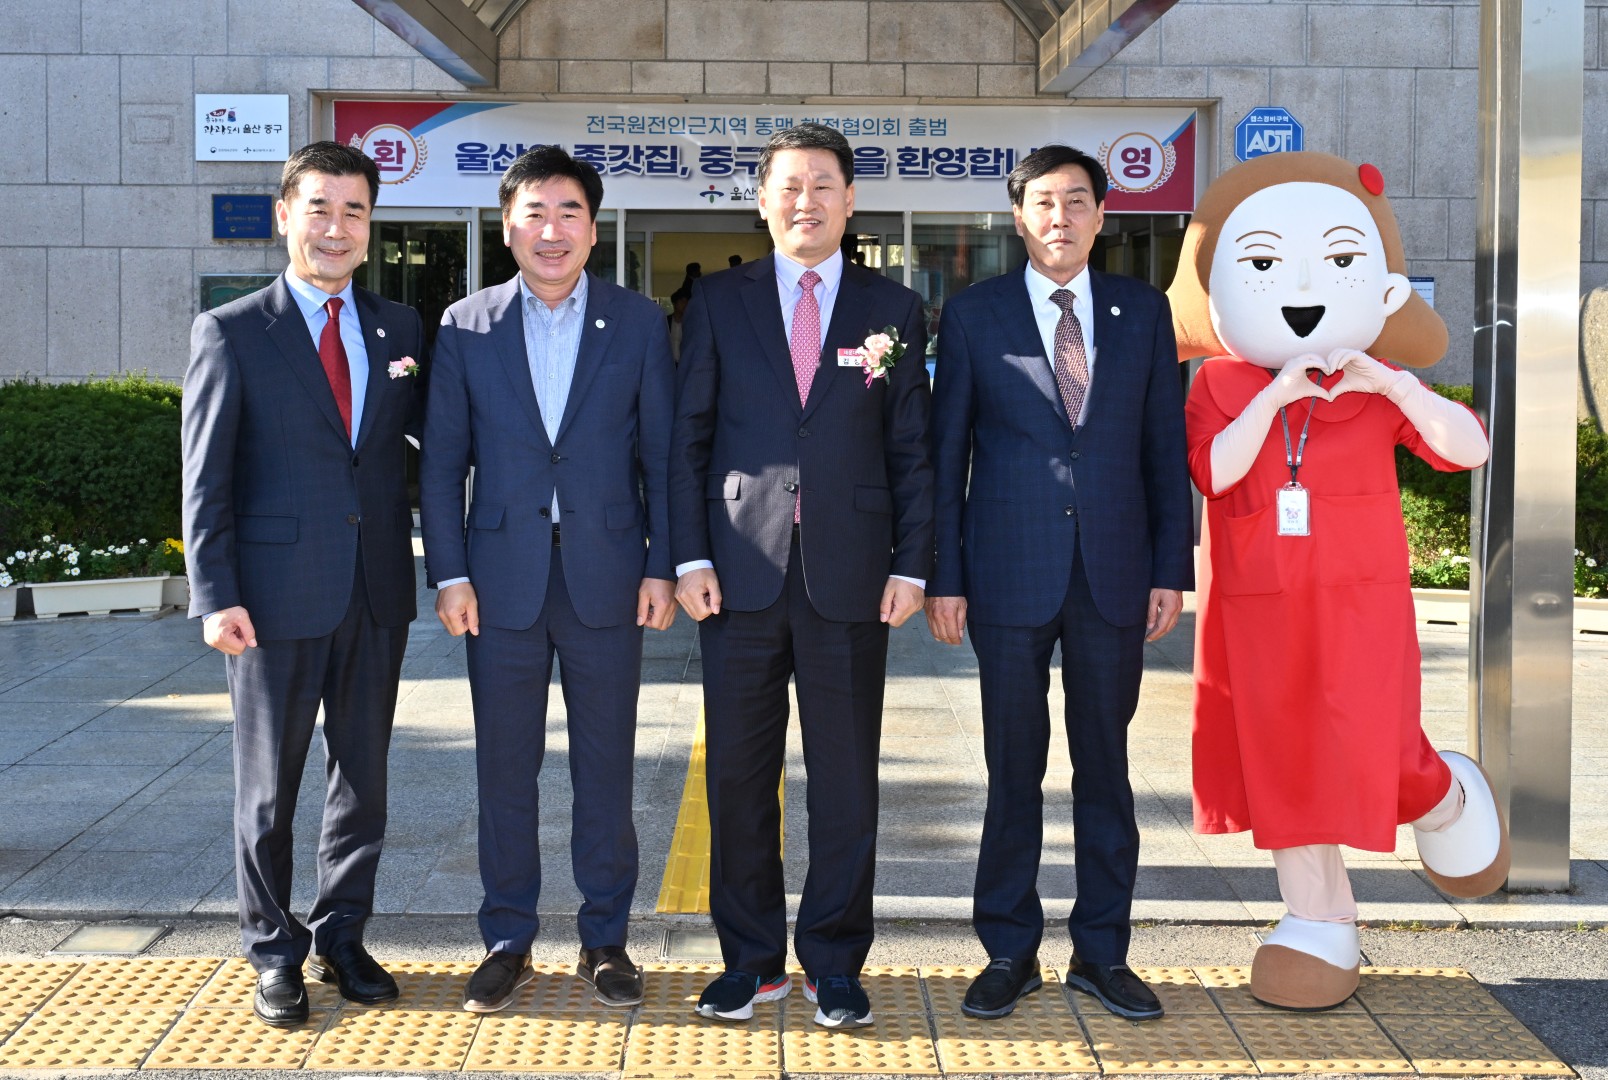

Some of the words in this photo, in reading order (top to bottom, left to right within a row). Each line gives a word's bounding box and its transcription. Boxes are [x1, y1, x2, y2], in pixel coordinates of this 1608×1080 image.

[203, 124, 239, 136] 관광도시
[243, 123, 261, 134] 울산
[264, 124, 282, 134] 중구
[586, 115, 747, 136] 전국원전인근지역
[908, 117, 947, 137] 출범
[1247, 129, 1292, 153] ADT
[373, 139, 407, 172] 환
[455, 142, 562, 171] 울산
[573, 143, 689, 176] 종갓집,
[1121, 147, 1152, 179] 영
